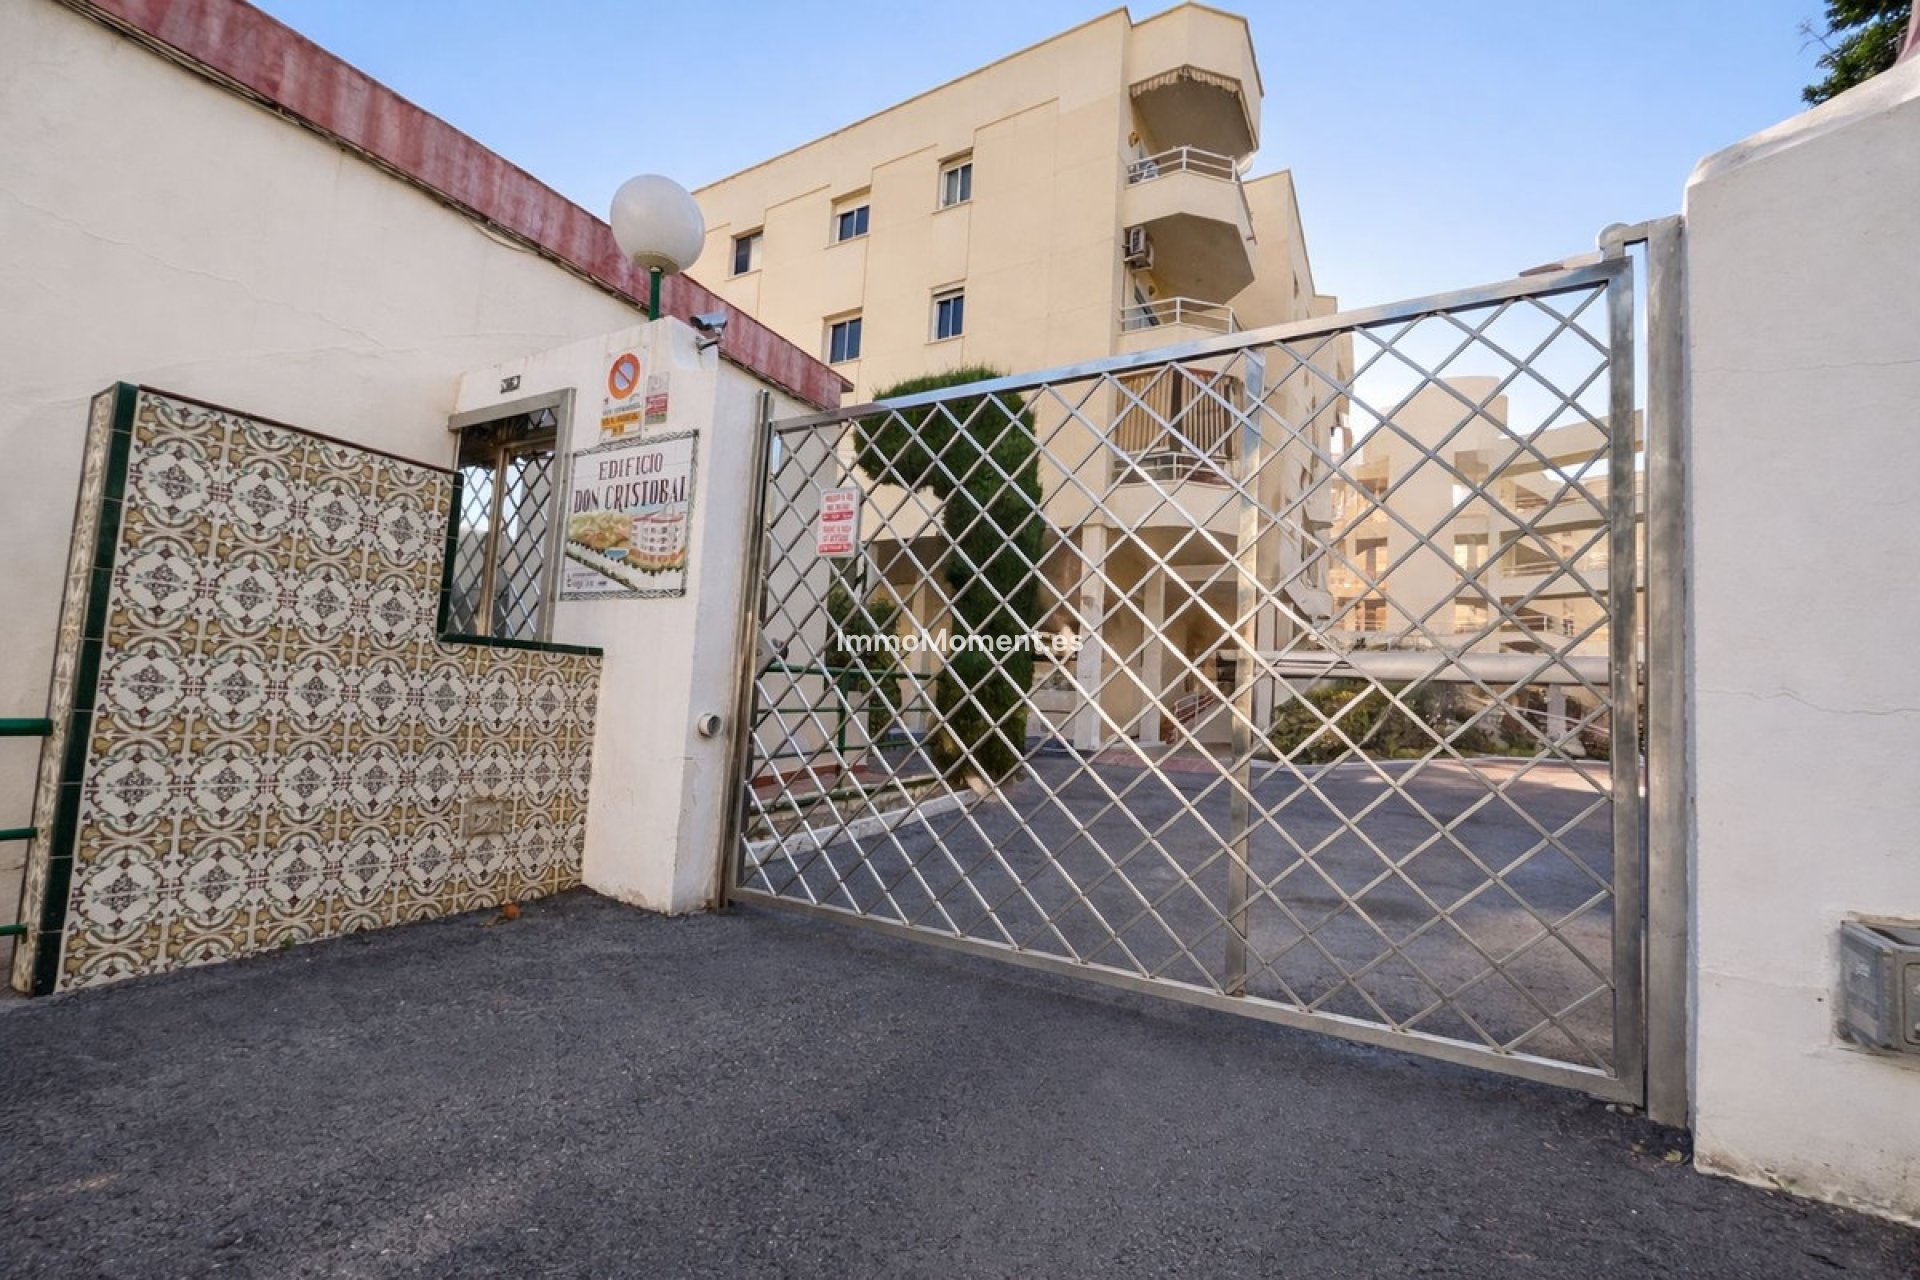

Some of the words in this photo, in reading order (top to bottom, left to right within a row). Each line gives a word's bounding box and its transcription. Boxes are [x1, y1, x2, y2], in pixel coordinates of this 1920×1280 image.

[599, 452, 664, 480] EDIFICIO
[574, 486, 600, 513] DON
[604, 475, 687, 512] CRISTOBAL
